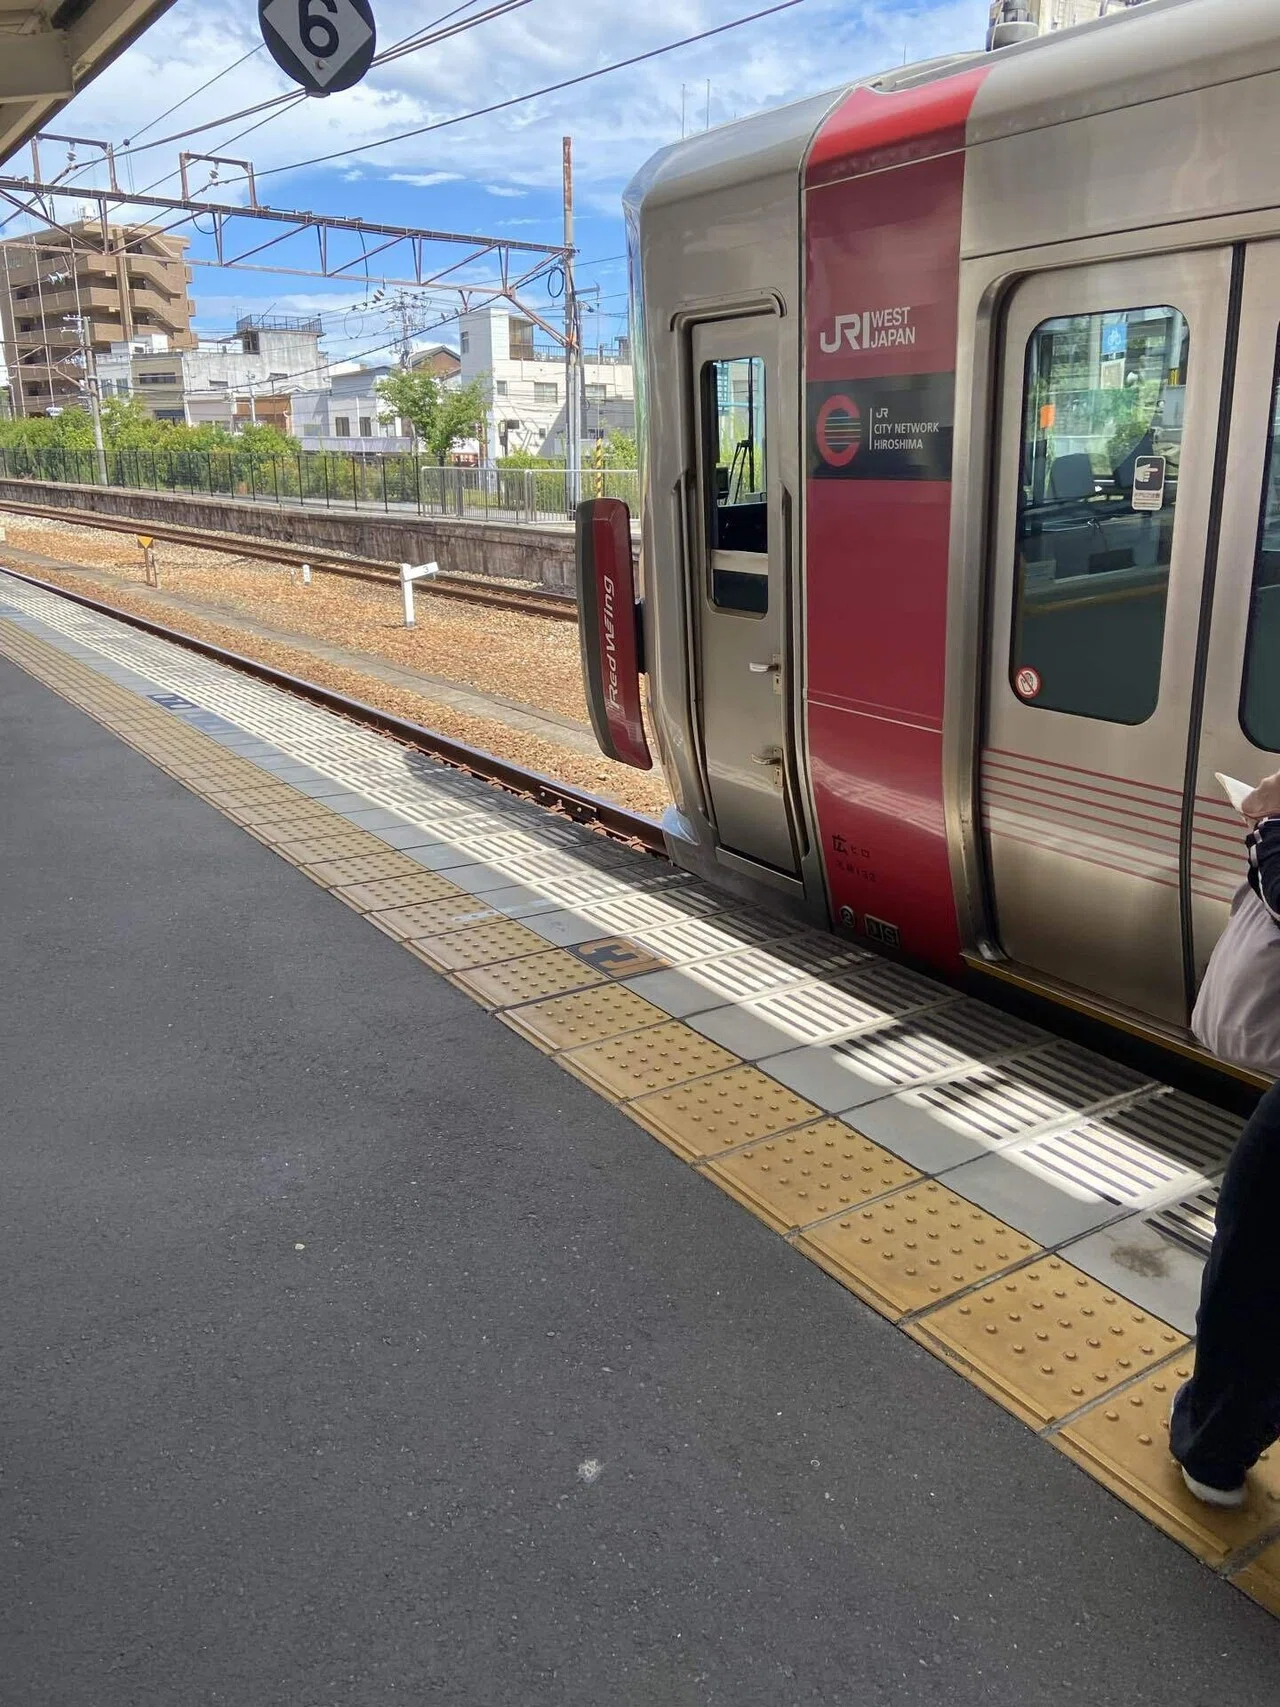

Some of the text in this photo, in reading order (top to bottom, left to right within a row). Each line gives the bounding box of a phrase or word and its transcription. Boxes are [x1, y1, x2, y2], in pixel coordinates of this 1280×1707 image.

[298, 0, 340, 58] 6
[820, 307, 911, 354] JR WEST
[870, 326, 916, 348] JAPAN
[875, 407, 889, 418] JR
[874, 422, 940, 435] CITY NETWORK
[873, 439, 924, 450] HIROSHIMA
[603, 575, 620, 710] Red Wing
